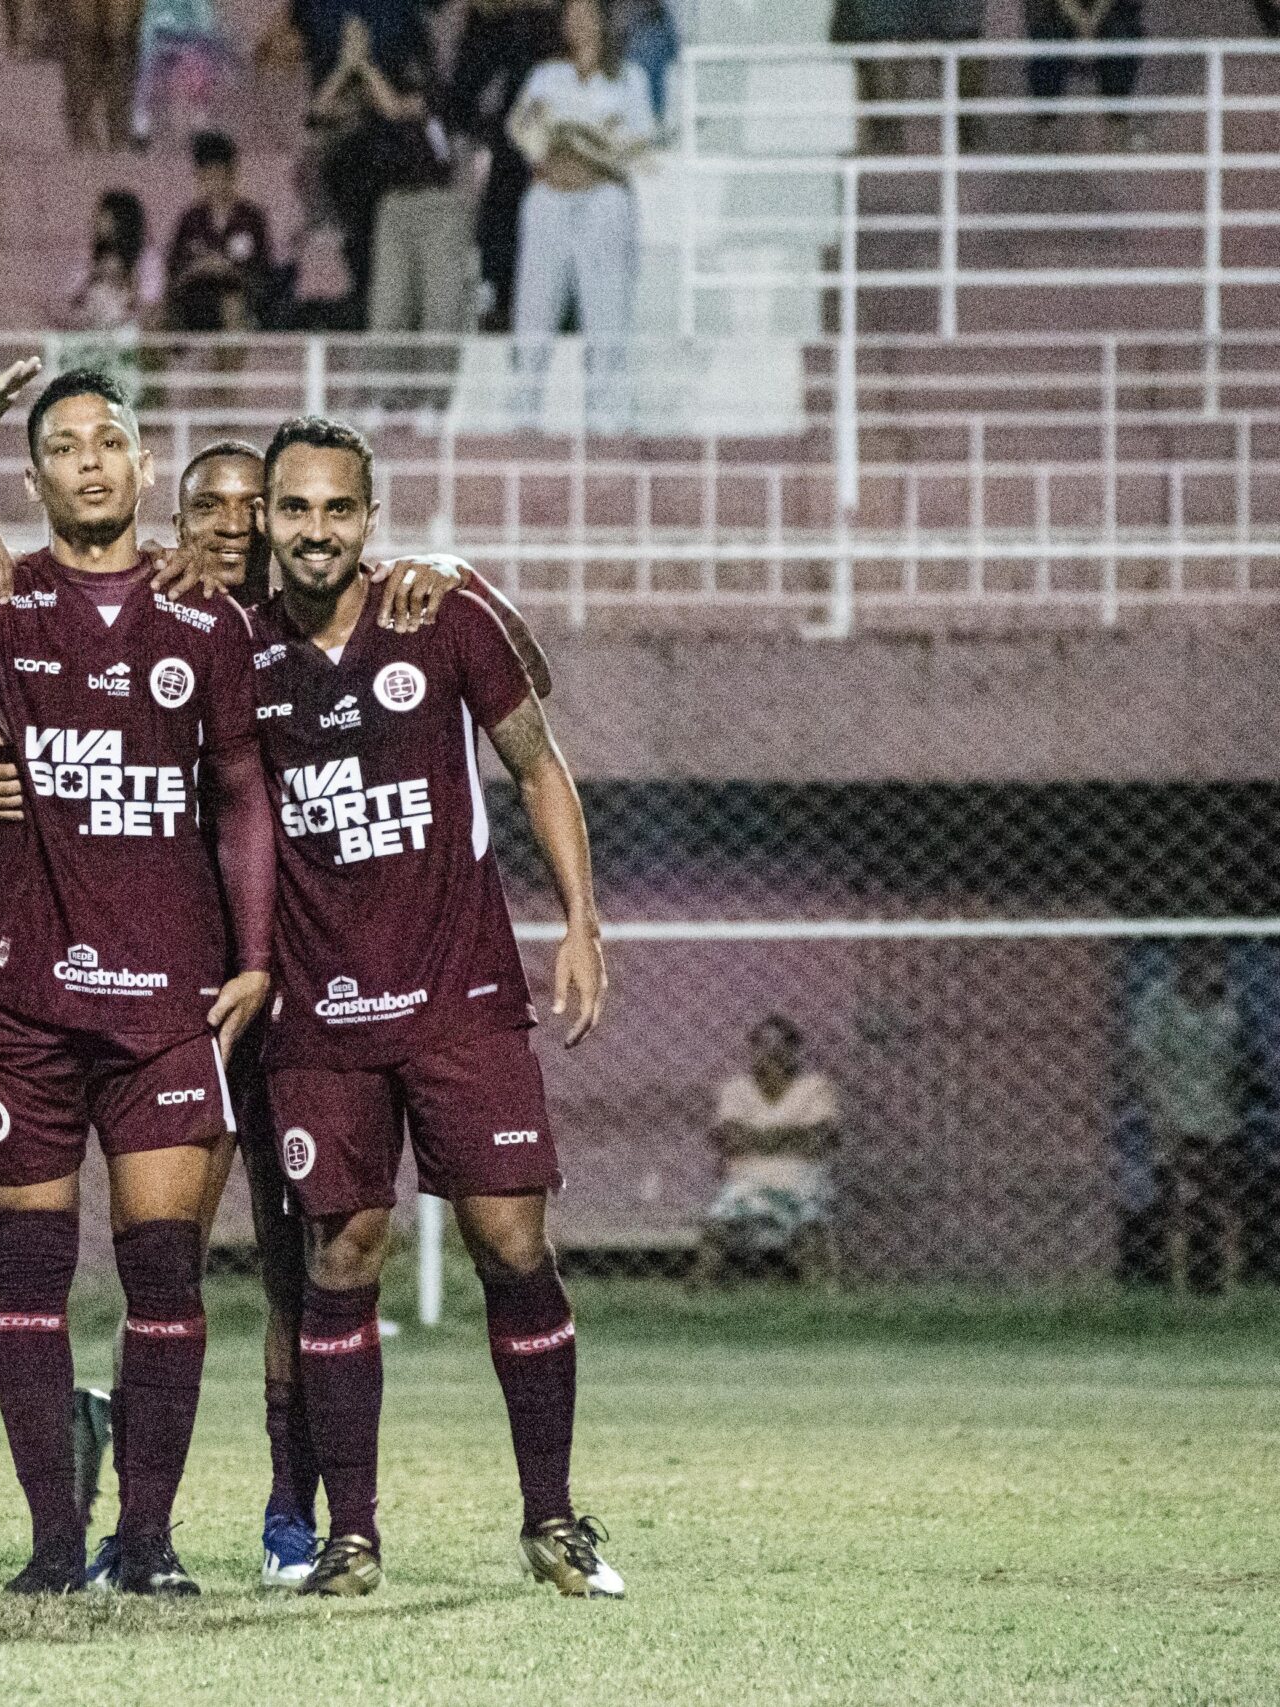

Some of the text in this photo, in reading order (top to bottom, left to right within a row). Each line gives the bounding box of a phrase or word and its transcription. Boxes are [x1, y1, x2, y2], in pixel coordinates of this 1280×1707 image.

[88, 674, 130, 691] bluzz
[320, 709, 361, 729] bluzz
[25, 726, 122, 764] VIVA
[28, 761, 186, 801] SORTE
[79, 800, 186, 837] .BET
[281, 778, 433, 837] SORTE
[334, 813, 433, 865] .BET
[53, 962, 168, 988] Construbom
[315, 989, 428, 1017] Construbom
